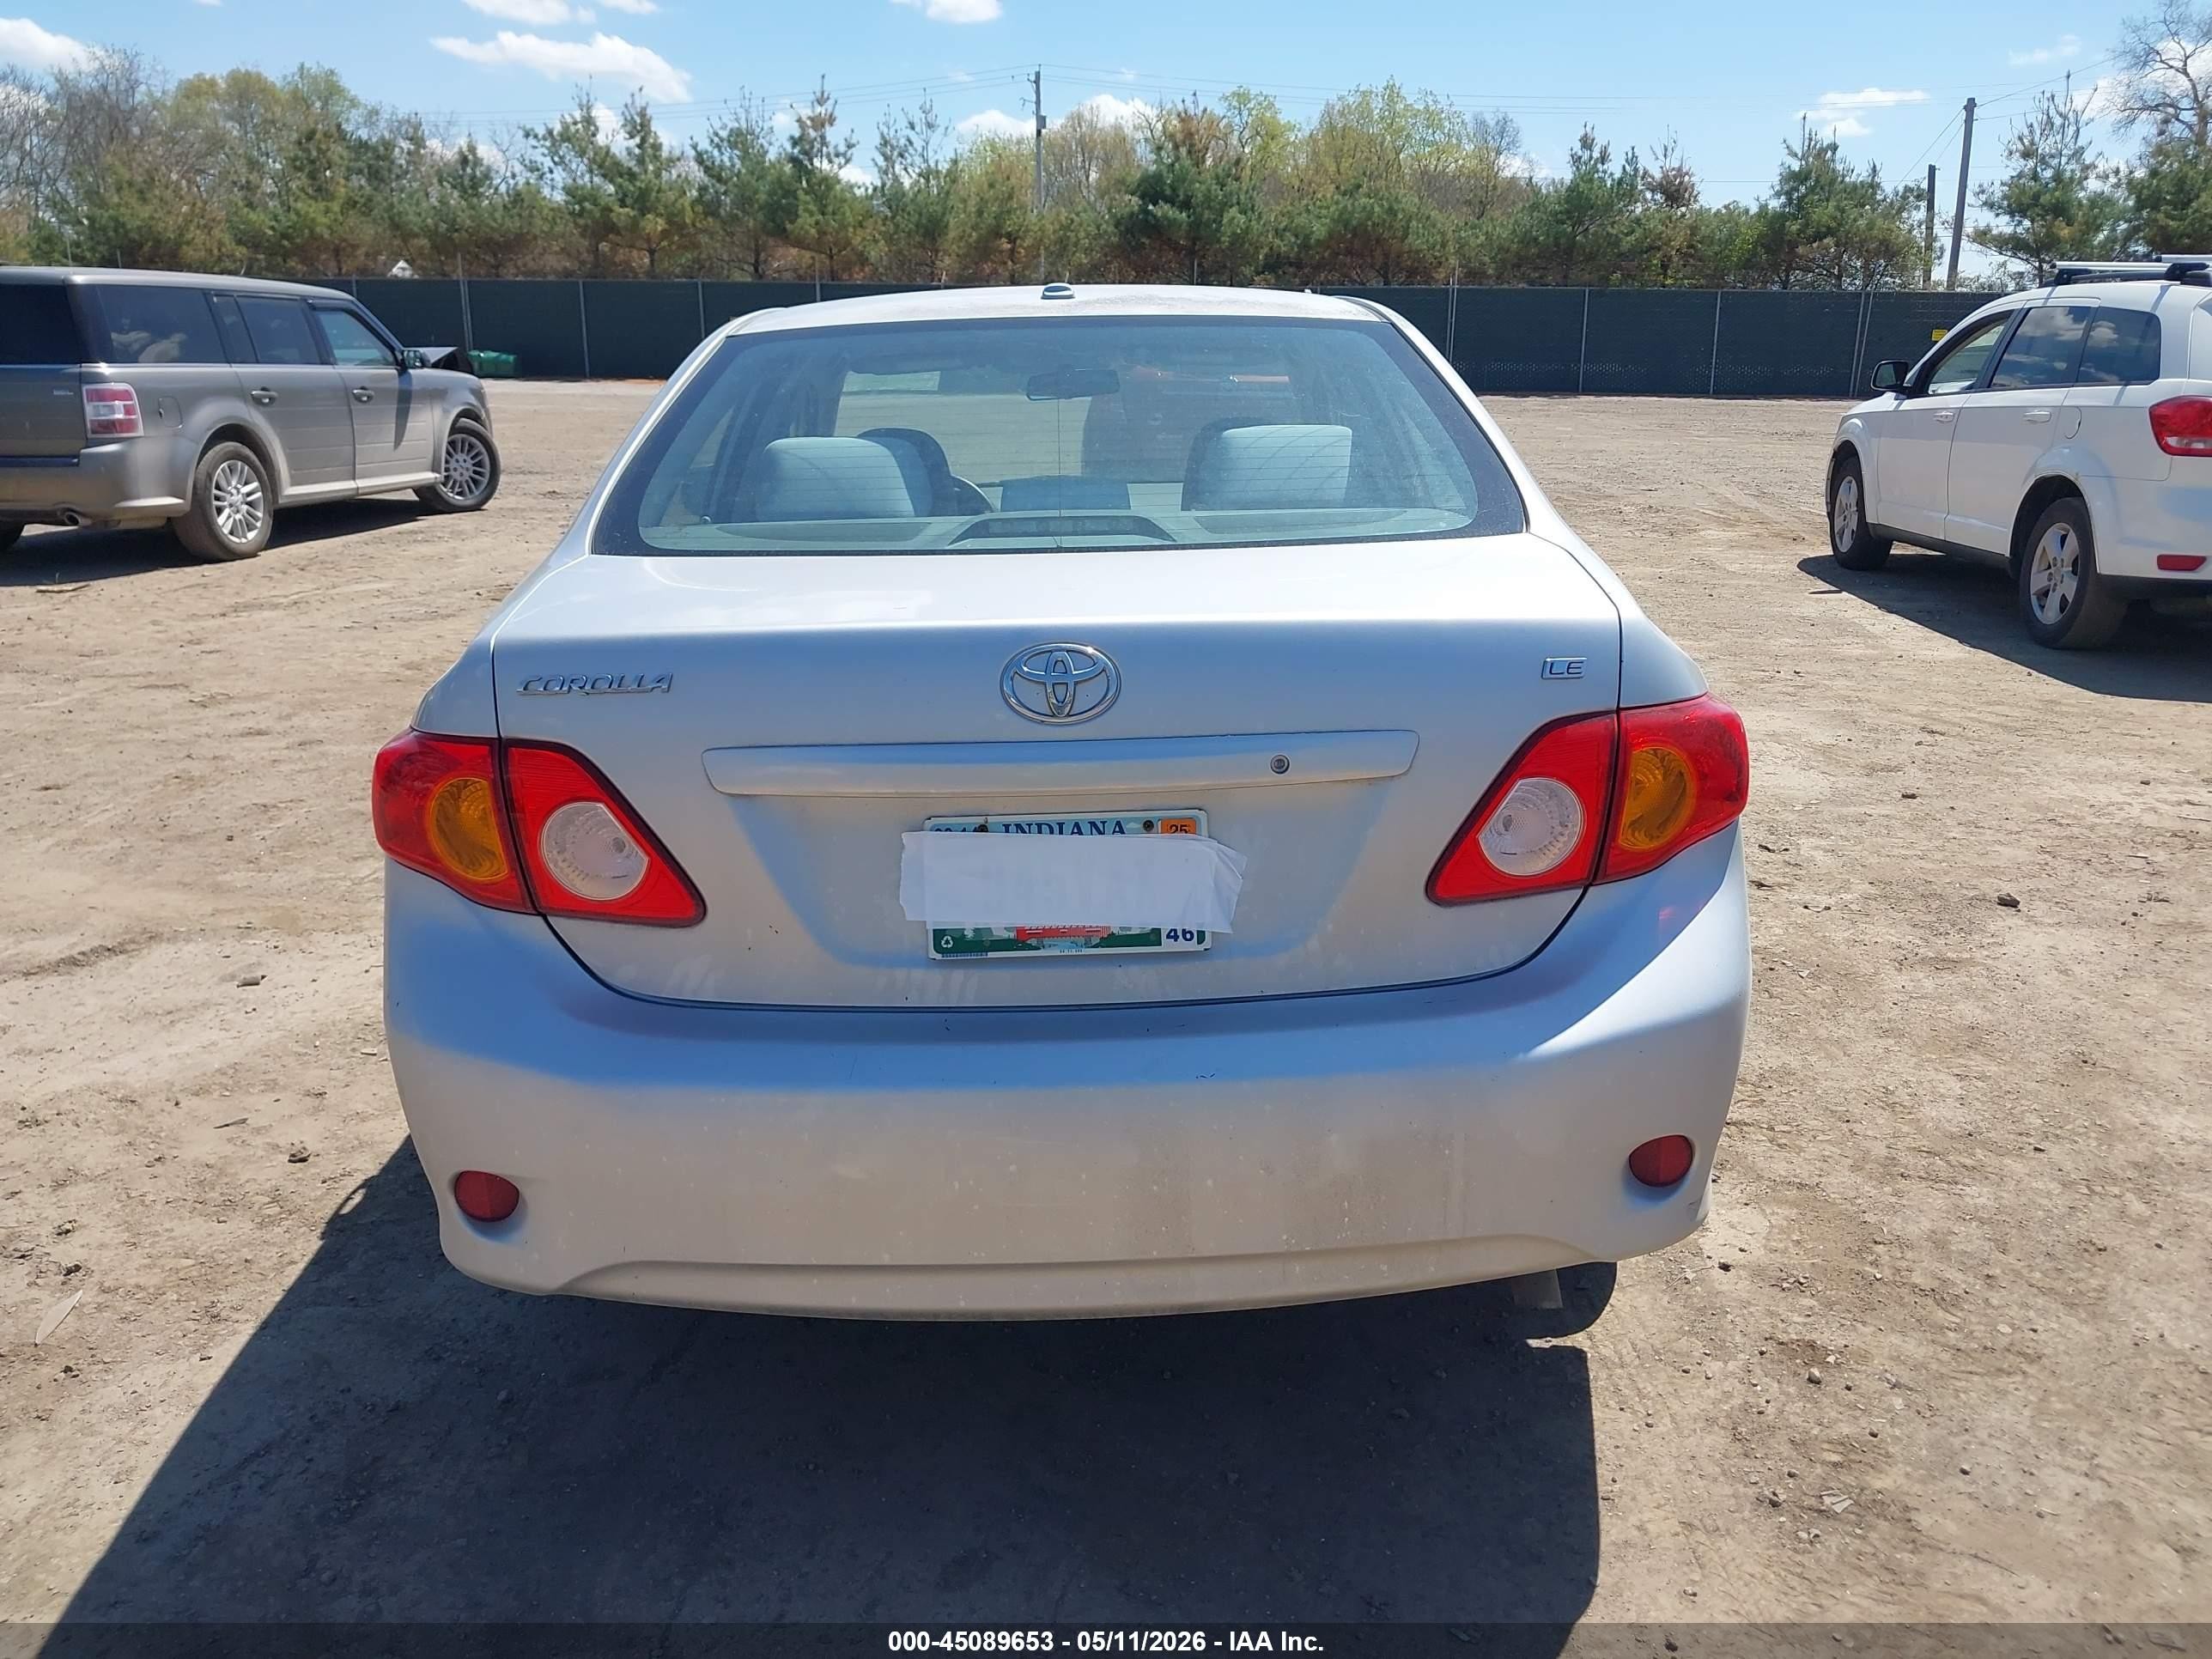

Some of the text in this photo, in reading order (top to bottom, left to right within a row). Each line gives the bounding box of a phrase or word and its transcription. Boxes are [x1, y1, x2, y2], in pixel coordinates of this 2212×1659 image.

[1544, 658, 1585, 678] LE
[517, 673, 672, 695] COROLLA
[1002, 820, 1126, 836] INDIANA
[1165, 927, 1195, 943] 46
